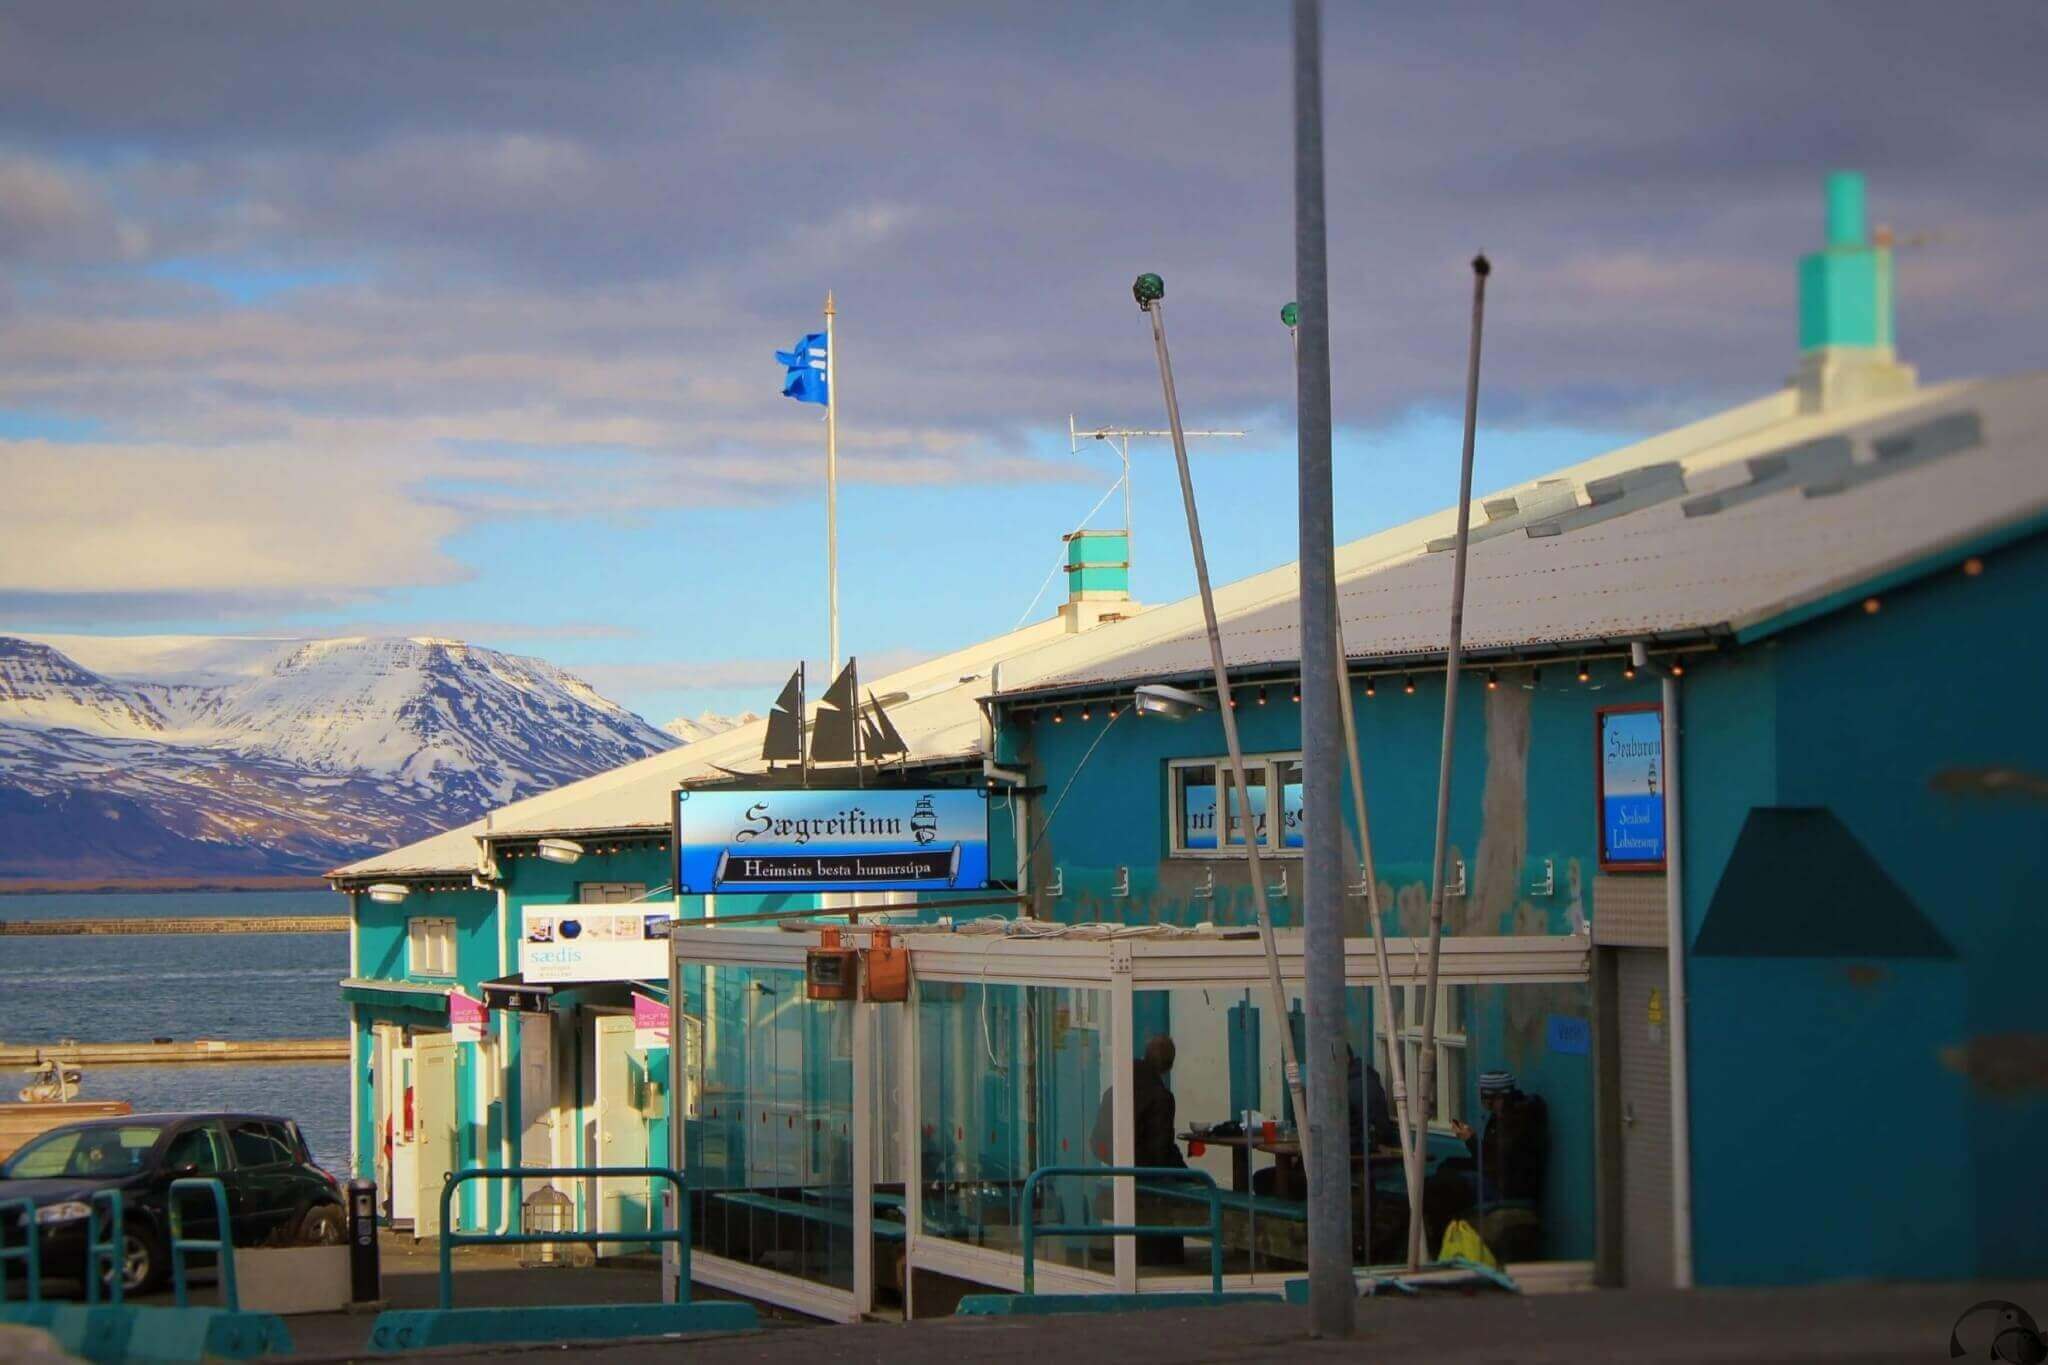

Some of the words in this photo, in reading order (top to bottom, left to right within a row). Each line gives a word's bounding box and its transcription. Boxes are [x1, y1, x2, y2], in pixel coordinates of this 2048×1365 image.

[736, 802, 901, 844] Sægreifinn
[744, 859, 811, 877] Heimsins
[817, 858, 851, 876] besta
[856, 858, 931, 879] humarsúpa
[530, 946, 582, 962] sædis
